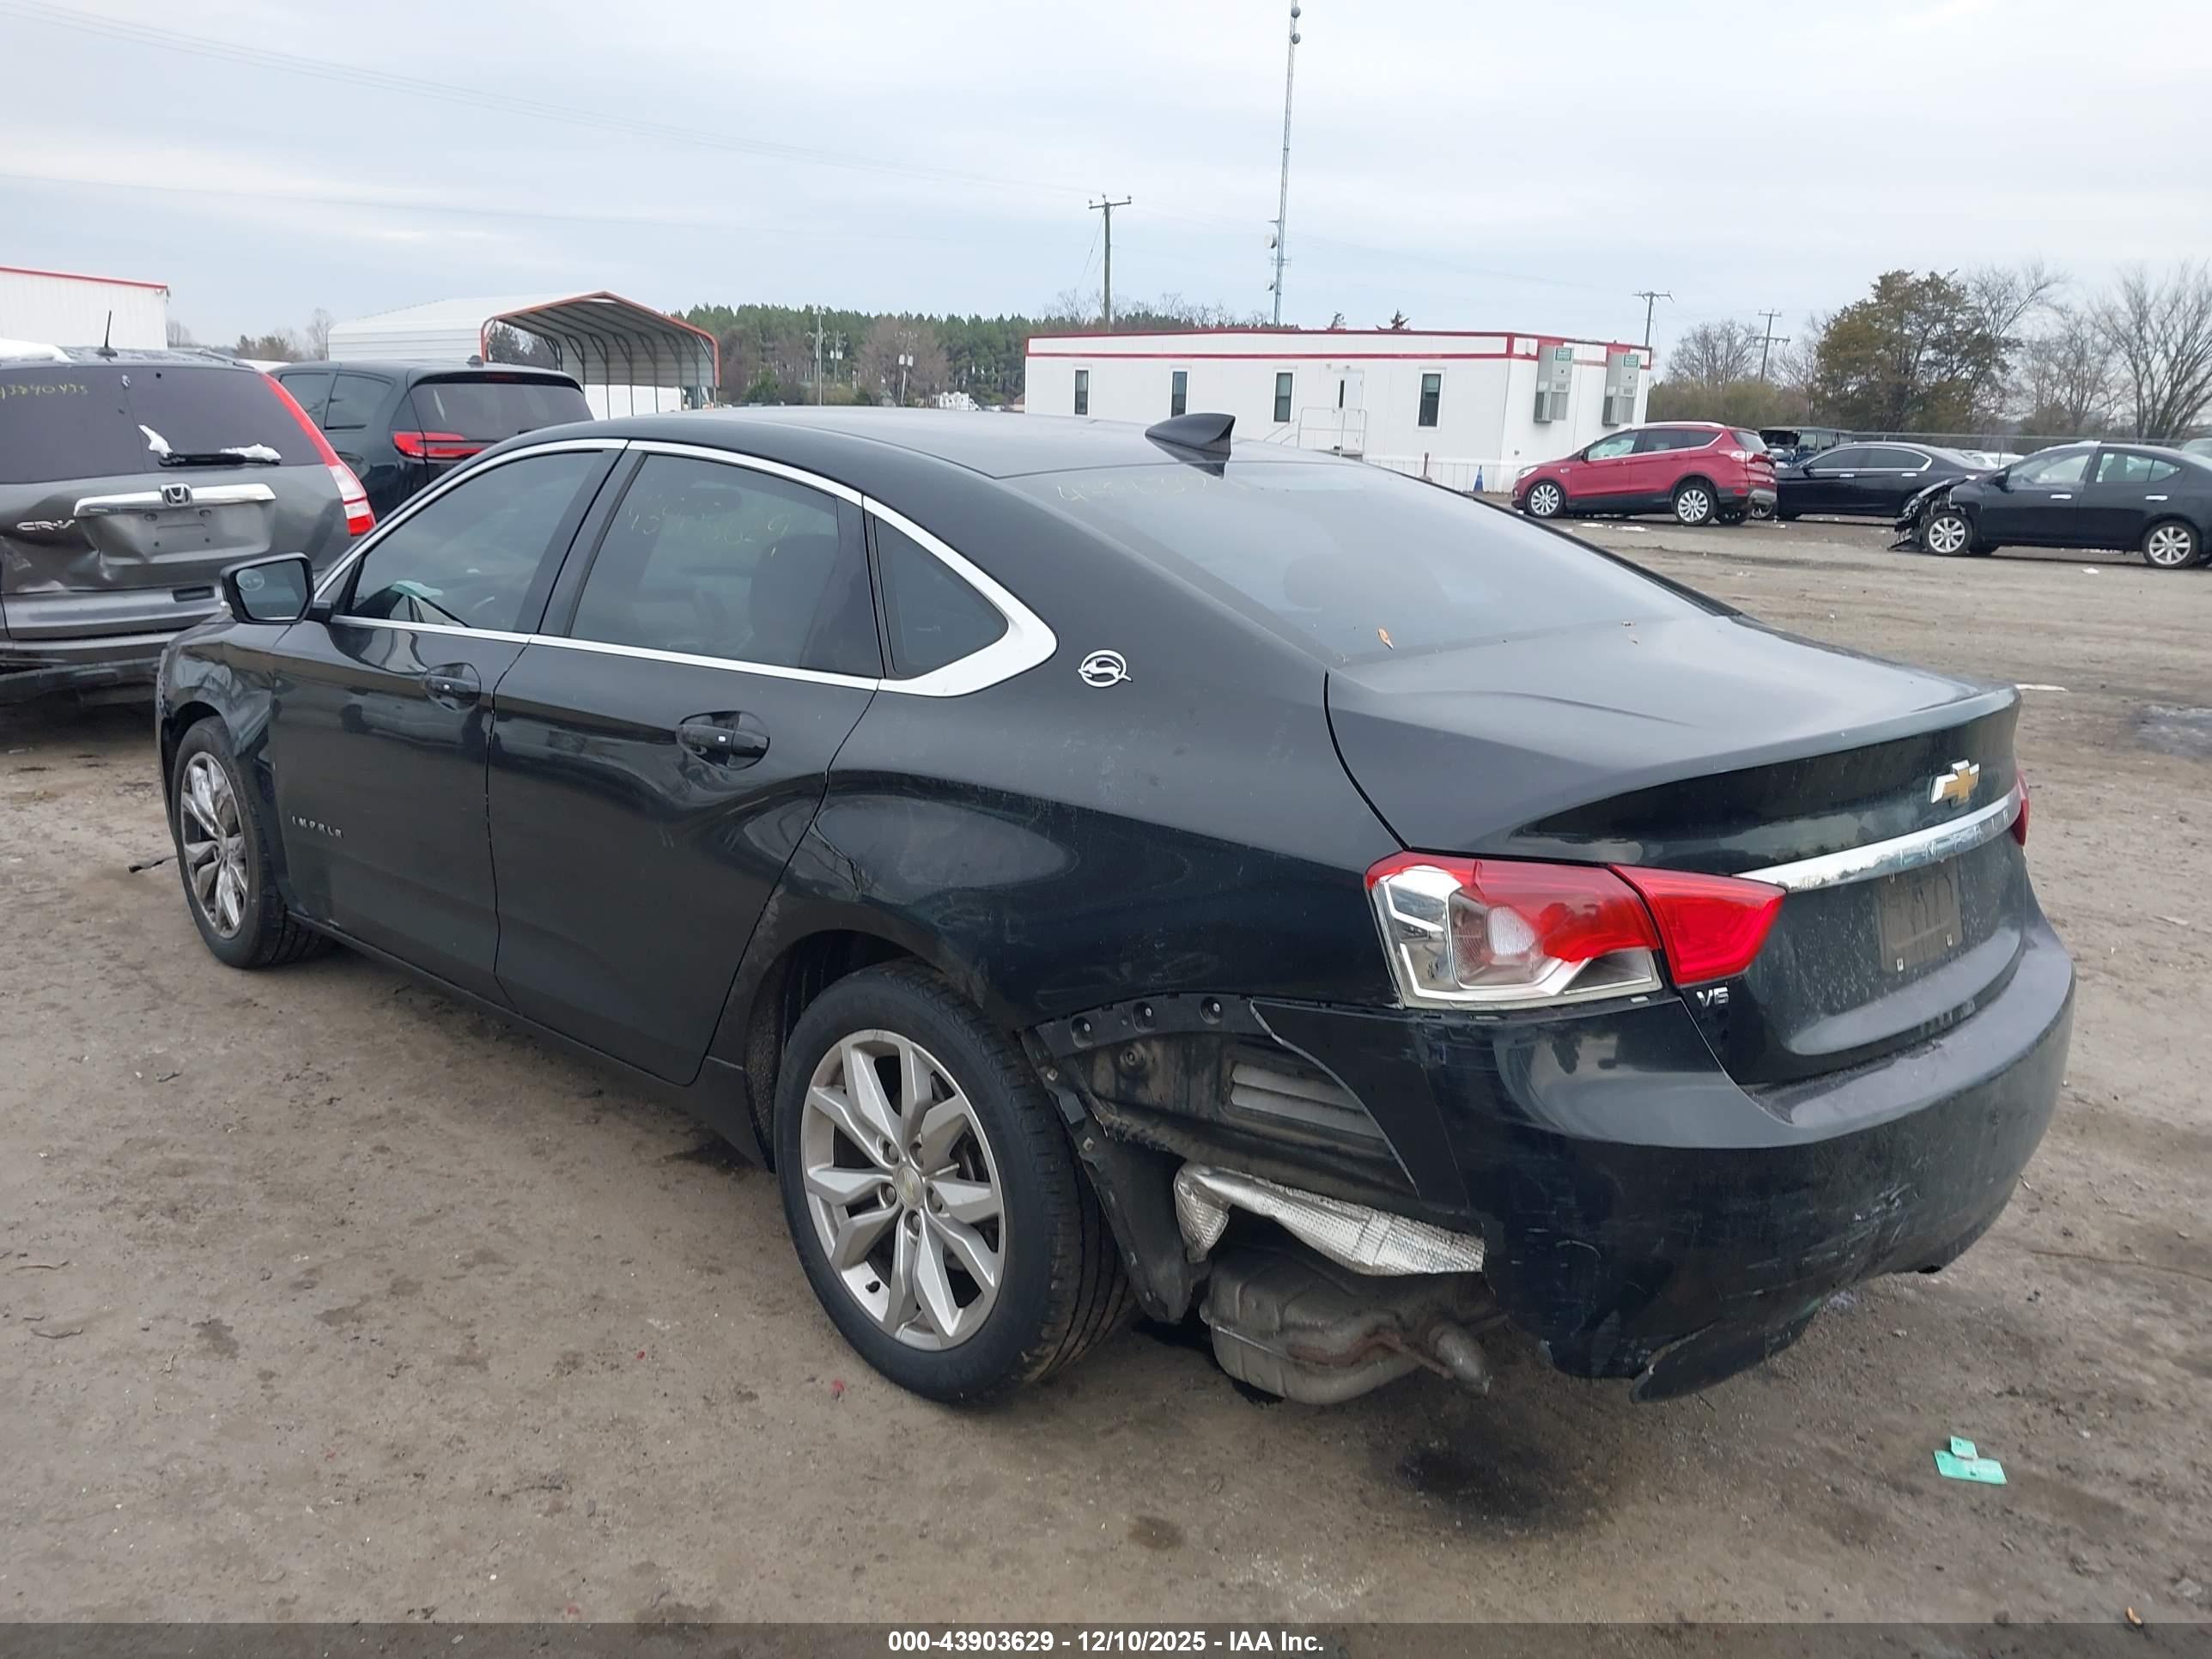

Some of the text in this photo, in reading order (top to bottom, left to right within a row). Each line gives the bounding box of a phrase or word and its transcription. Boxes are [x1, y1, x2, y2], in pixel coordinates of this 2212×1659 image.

[15, 519, 76, 532] CR-V
[291, 815, 343, 839] IMPALA
[1696, 986, 1729, 1007] V6
